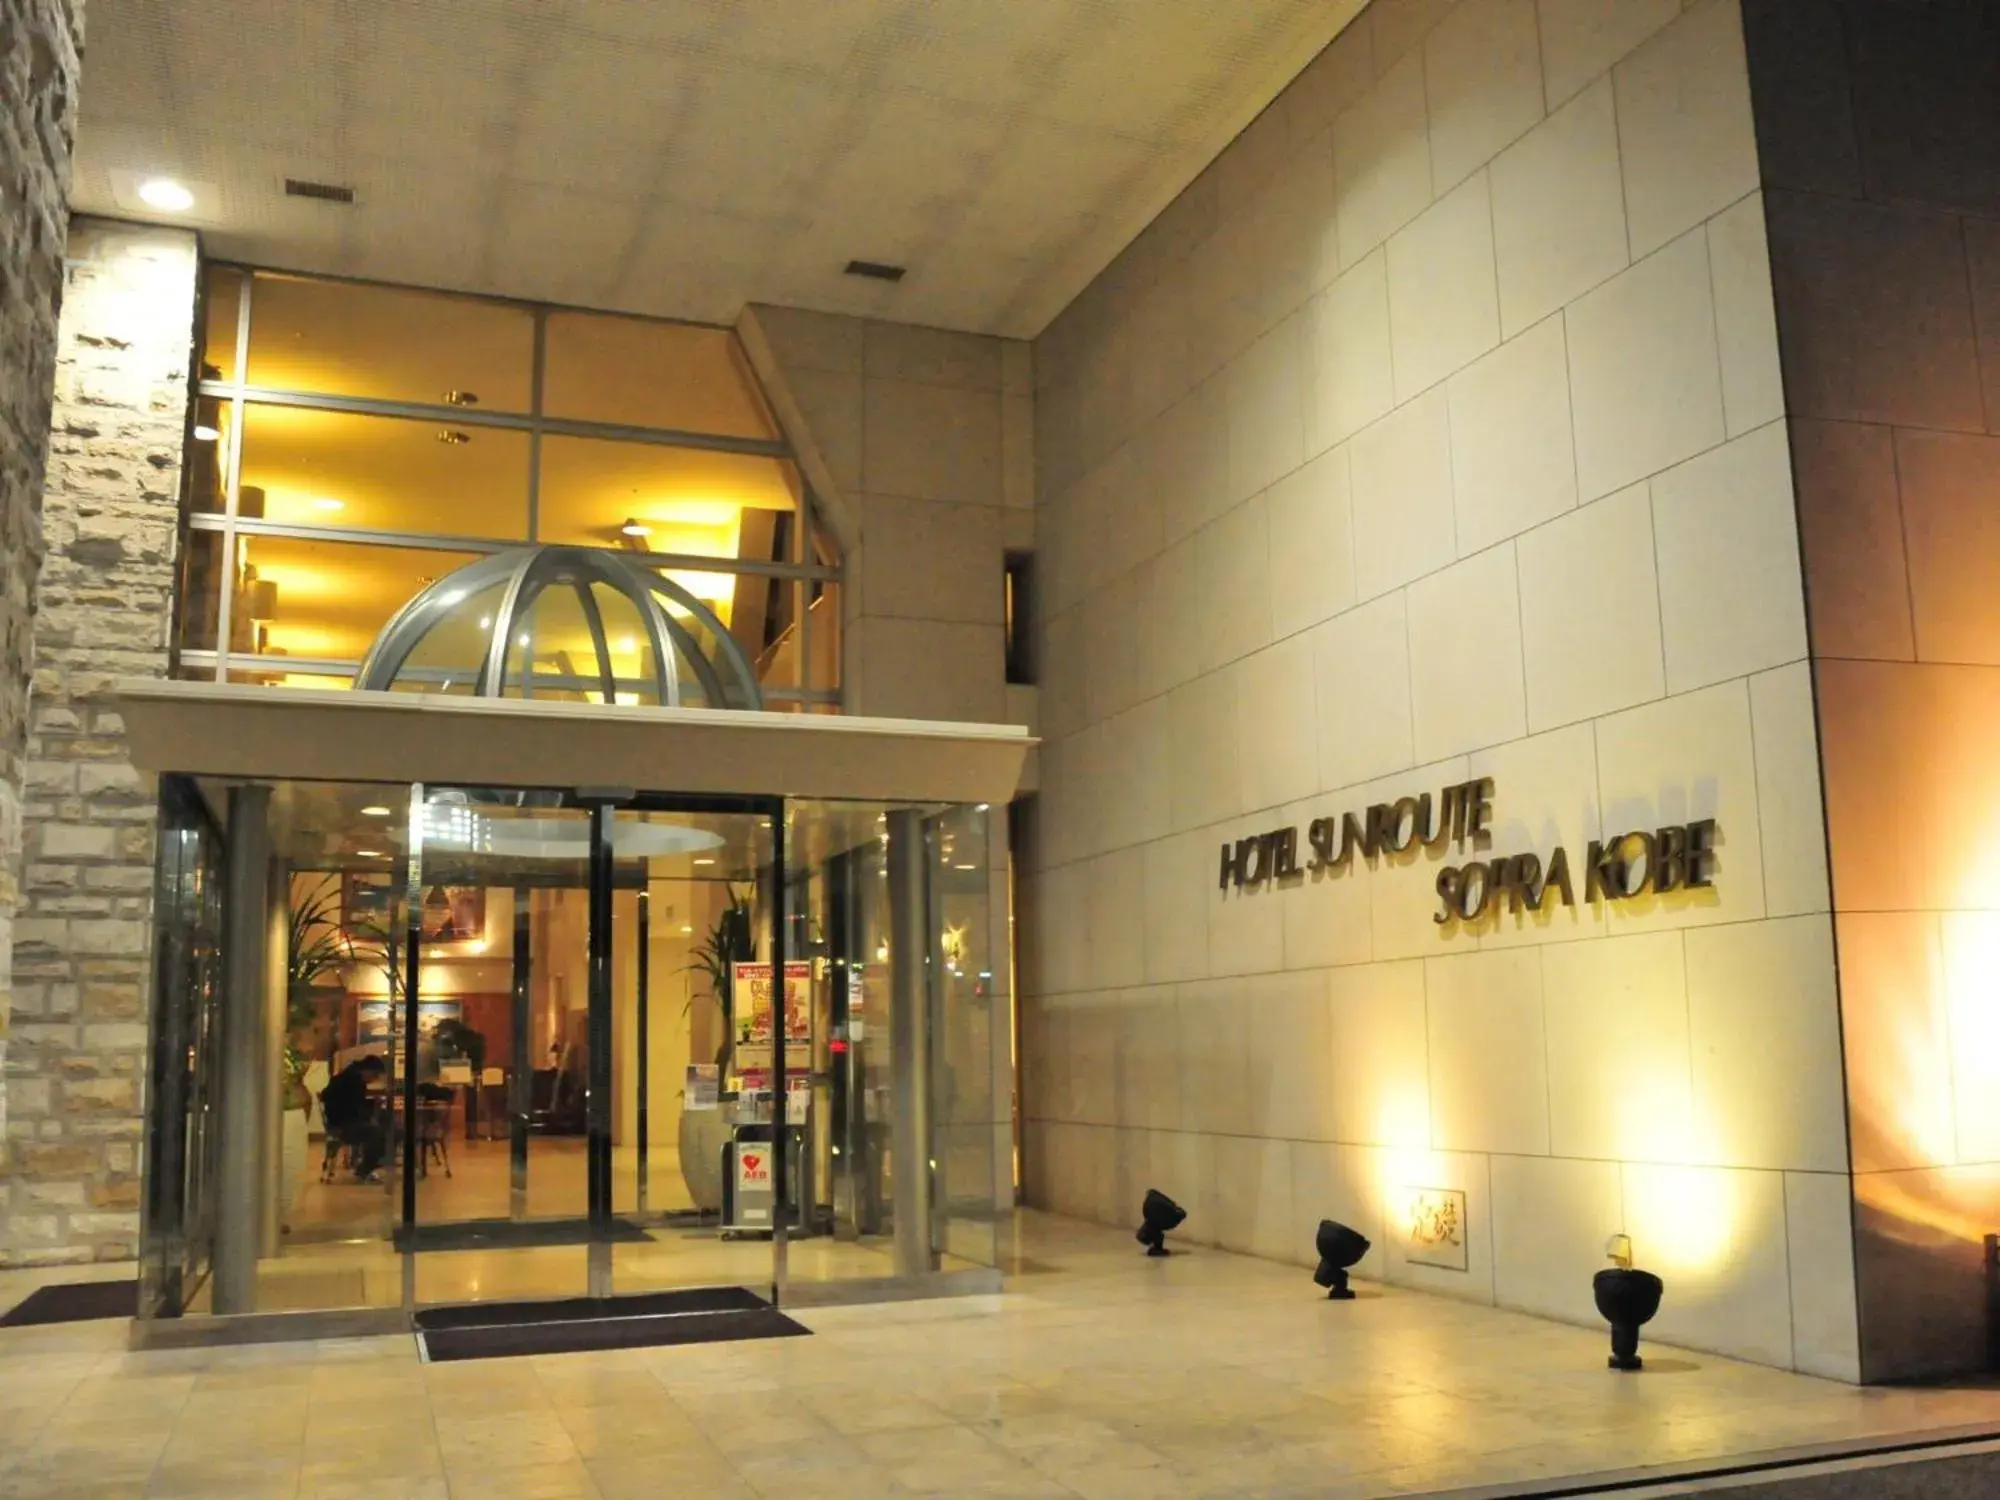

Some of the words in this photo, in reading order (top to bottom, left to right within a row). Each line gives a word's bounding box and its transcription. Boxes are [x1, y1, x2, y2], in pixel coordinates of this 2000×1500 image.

[1219, 826, 1304, 889] HOTEL
[1307, 776, 1494, 870] SUNROUTE
[1433, 847, 1574, 924] SOPRA
[1585, 819, 1716, 903] KOBE
